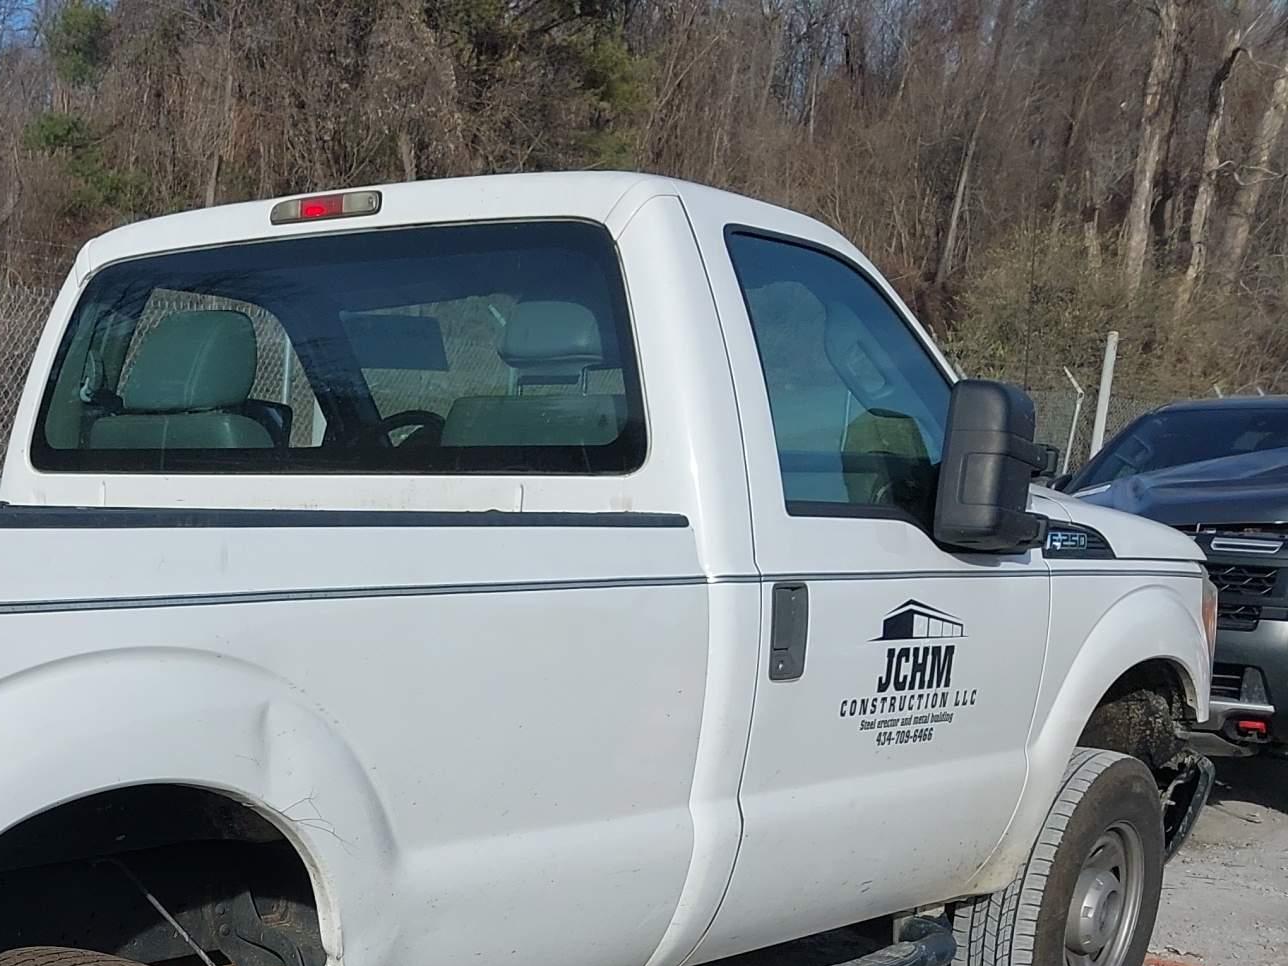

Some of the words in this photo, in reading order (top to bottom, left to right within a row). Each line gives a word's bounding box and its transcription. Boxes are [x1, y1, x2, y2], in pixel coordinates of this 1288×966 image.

[877, 645, 955, 692] JCHM
[840, 692, 948, 717] CONSTRUCTION
[954, 689, 977, 706] LLC
[900, 715, 912, 727] and
[876, 727, 934, 746] 434-709-6466
